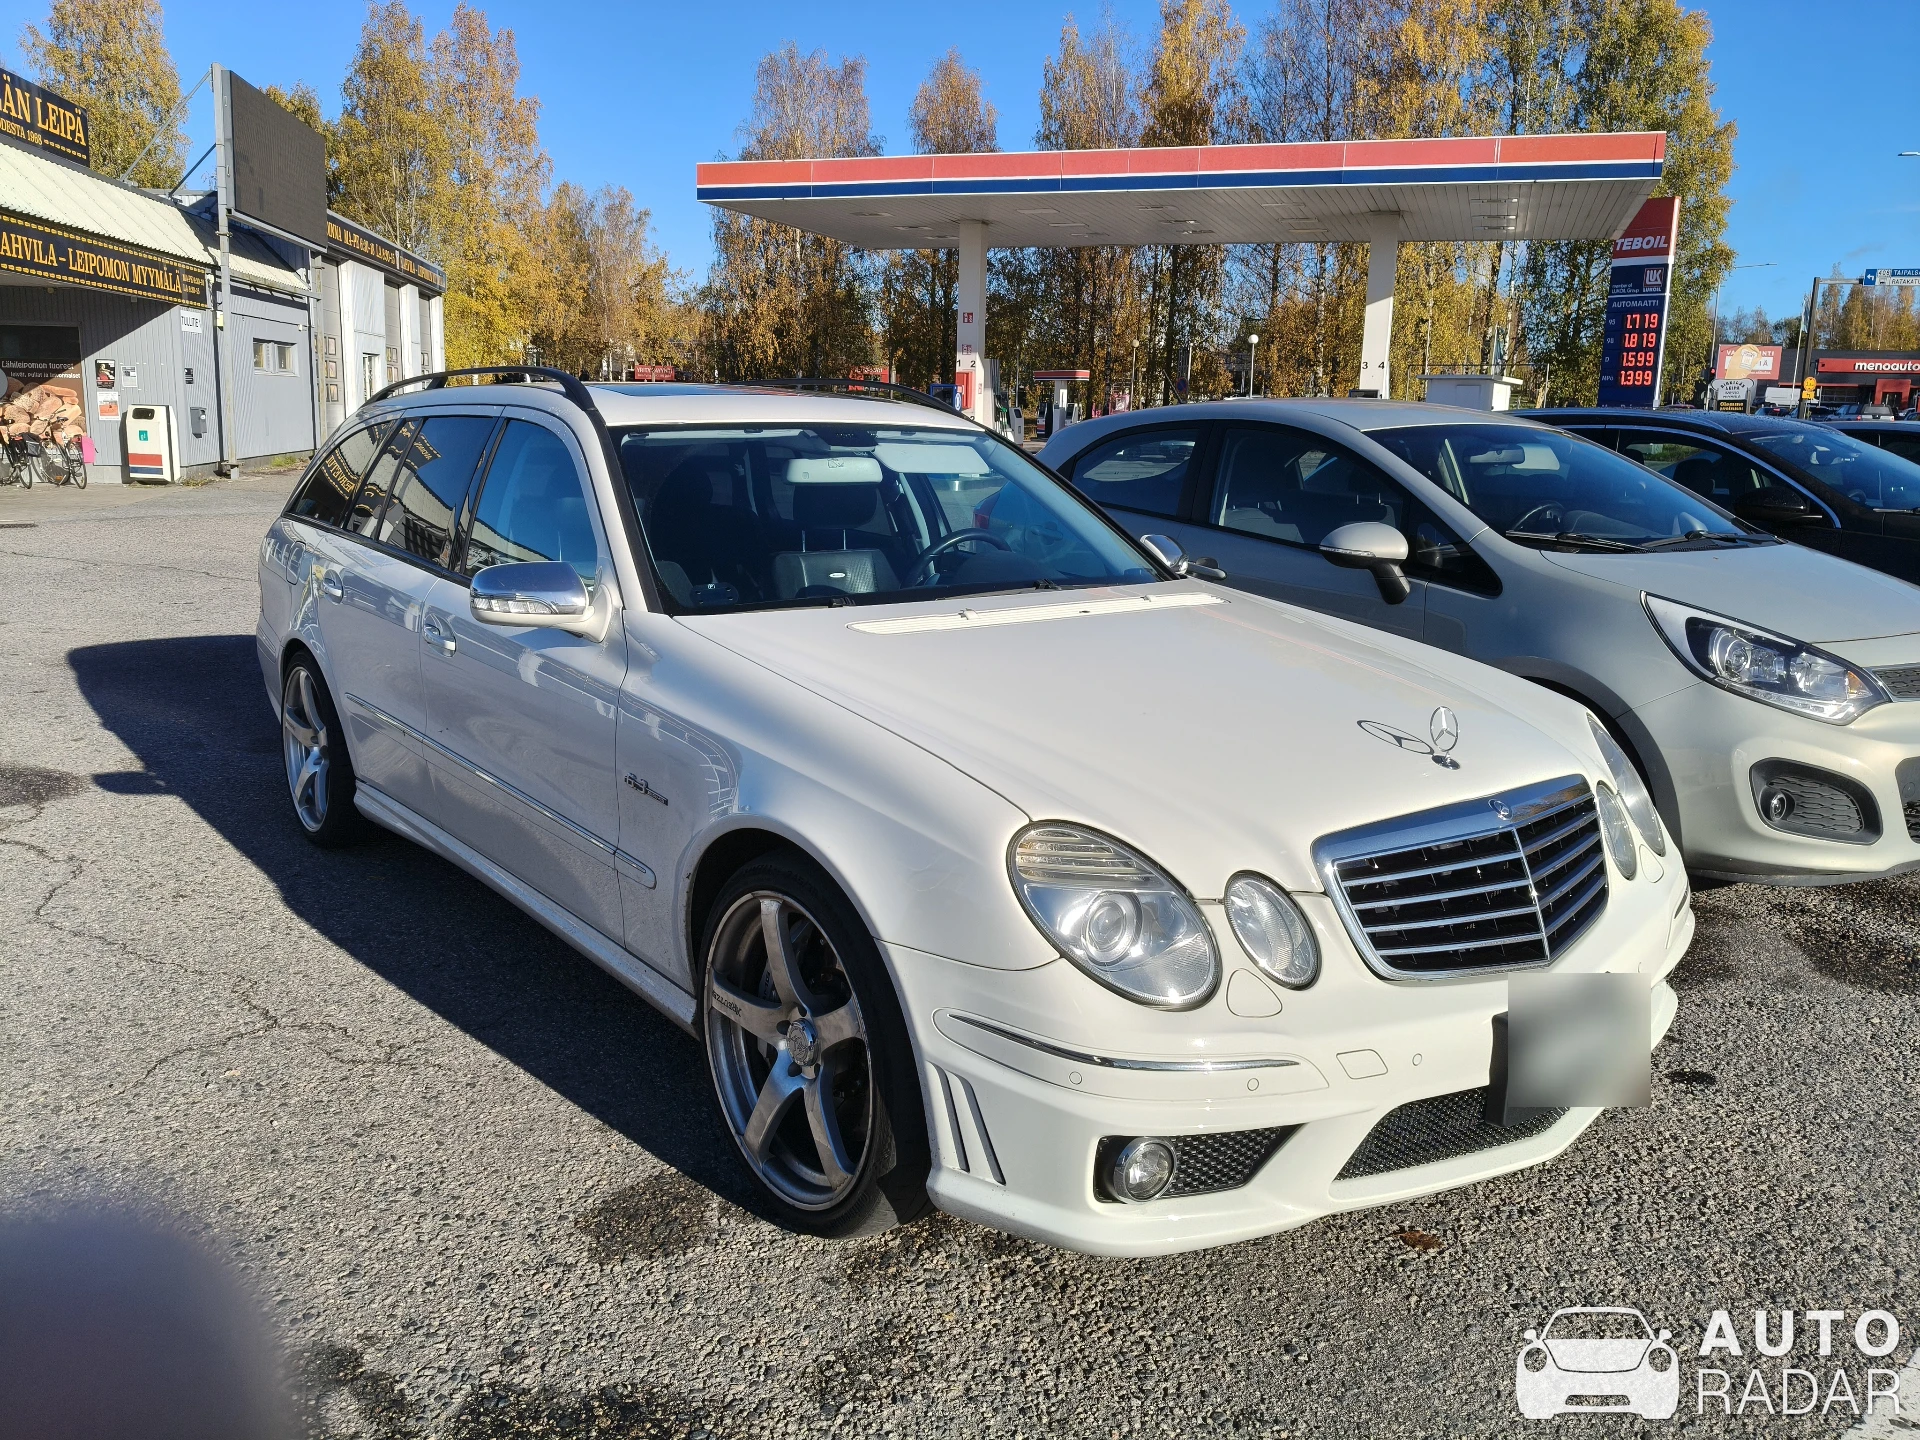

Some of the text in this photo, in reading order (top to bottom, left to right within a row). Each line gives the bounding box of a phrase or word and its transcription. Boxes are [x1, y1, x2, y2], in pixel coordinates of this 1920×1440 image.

[0, 73, 86, 146] ÄN LEIPÄ
[1616, 236, 1668, 251] TEBOIL
[68, 248, 130, 282] LEIPOMON
[131, 263, 182, 293] MYYMÄLÄ
[1612, 300, 1659, 308] AUTOMAATTI
[970, 360, 976, 368] 2
[1362, 361, 1384, 369] 3 4
[1855, 361, 1920, 371] menoauto
